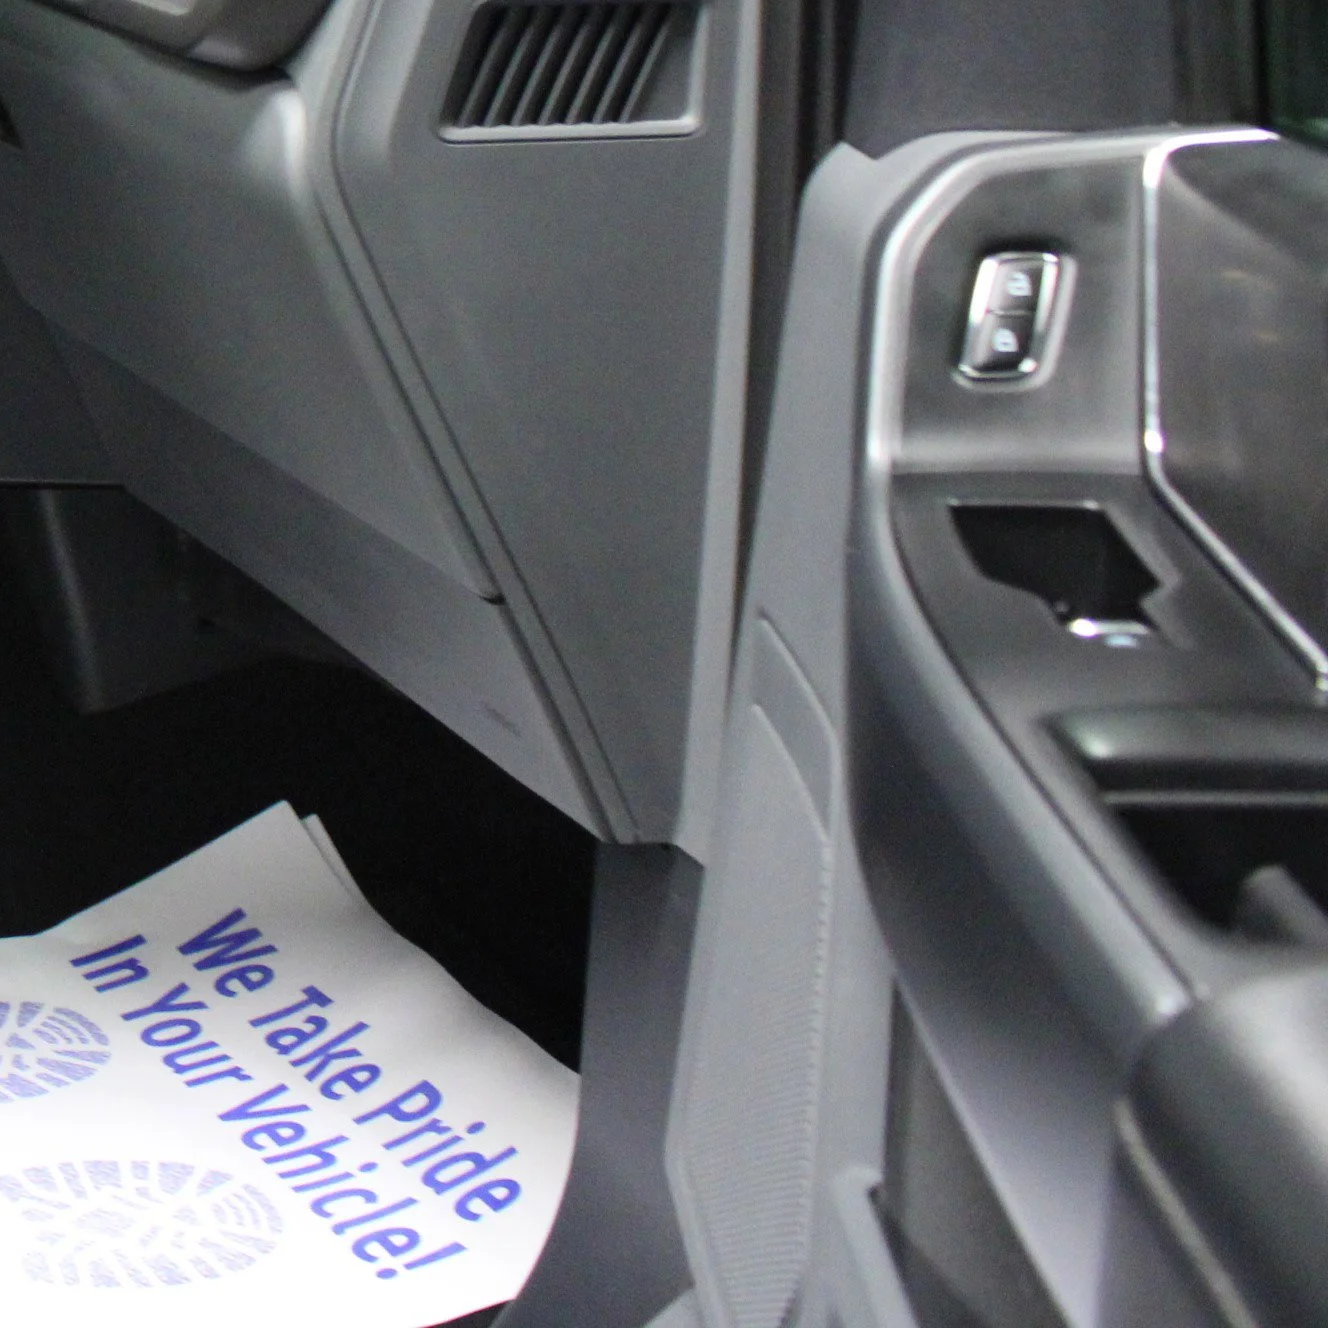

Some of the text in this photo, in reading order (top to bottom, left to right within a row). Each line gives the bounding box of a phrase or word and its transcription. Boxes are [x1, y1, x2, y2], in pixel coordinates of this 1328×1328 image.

[69, 934, 469, 1280] In Your Vehicle!
[176, 907, 522, 1223] We Take Pride
